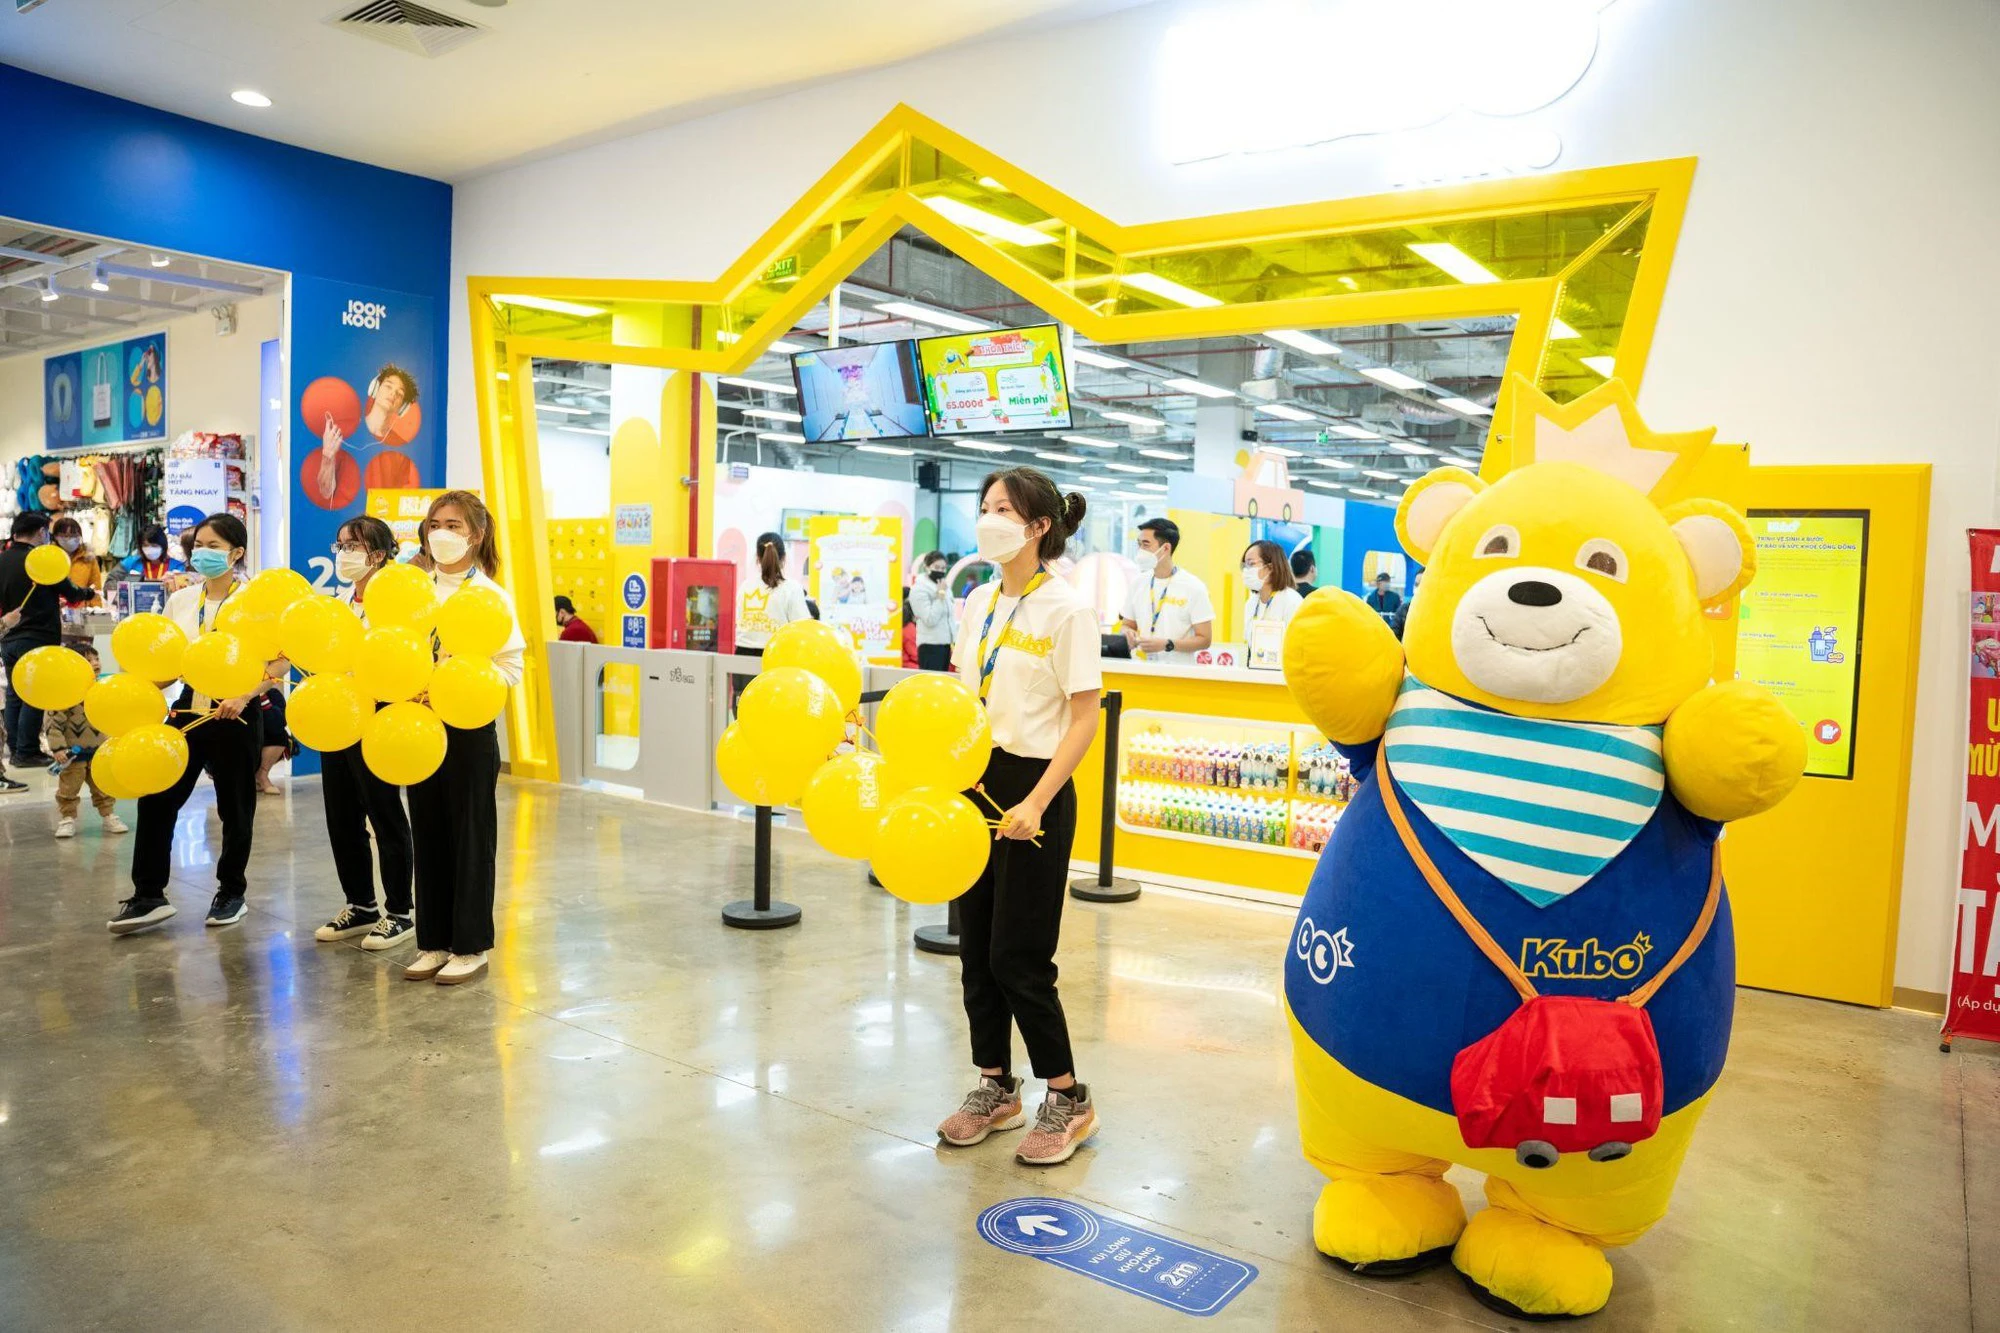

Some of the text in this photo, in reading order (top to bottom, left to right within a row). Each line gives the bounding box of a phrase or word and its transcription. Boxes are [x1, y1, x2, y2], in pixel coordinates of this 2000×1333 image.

[1008, 393, 1048, 405] Miễn phí
[858, 756, 879, 810] Kubo
[1520, 937, 1644, 979] Kubo
[1088, 1236, 1131, 1264] VUI LÒNG
[1138, 1254, 1165, 1273] CÁCH
[1158, 1262, 1200, 1287] 2m
